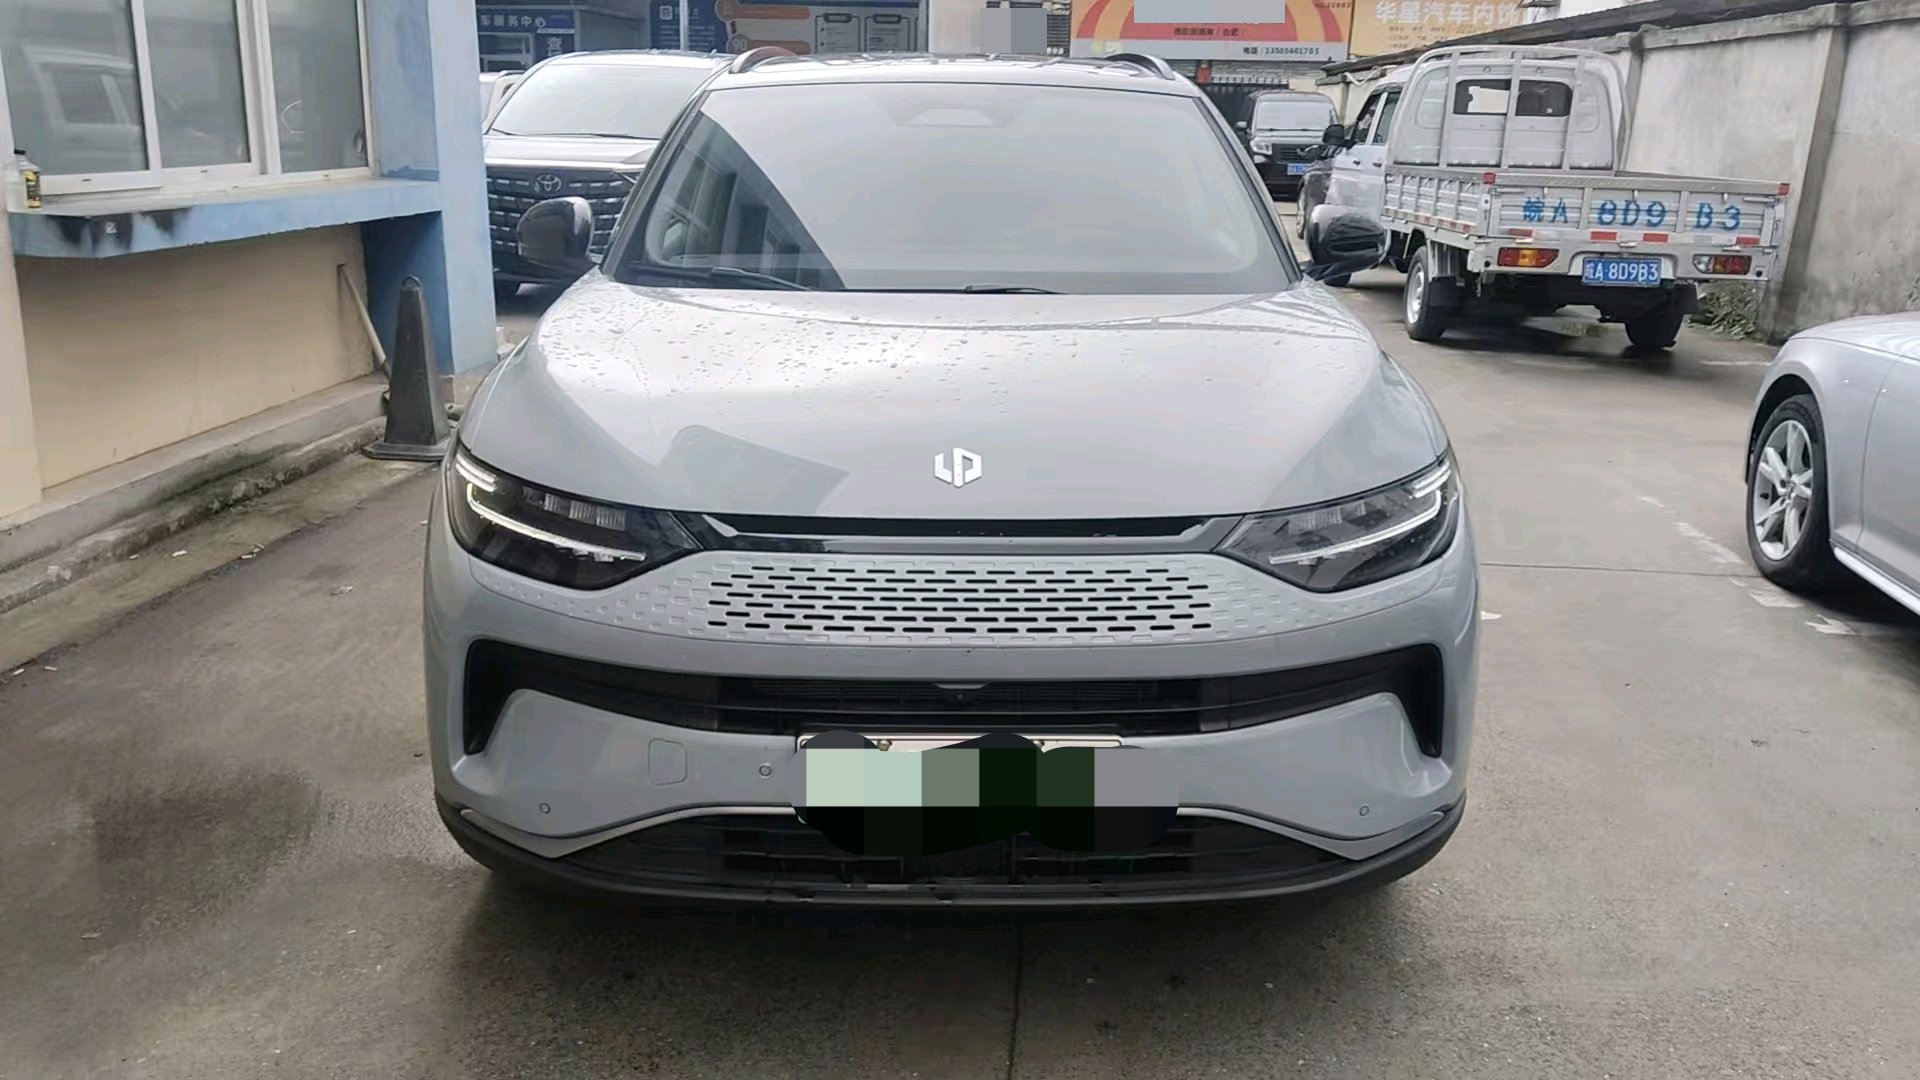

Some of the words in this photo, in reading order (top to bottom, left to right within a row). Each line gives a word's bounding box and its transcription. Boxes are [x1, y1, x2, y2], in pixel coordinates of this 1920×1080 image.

[1376, 1, 1521, 25] 华星汽车内饰
[1597, 200, 1667, 228] 8D9
[1695, 203, 1742, 230] B3
